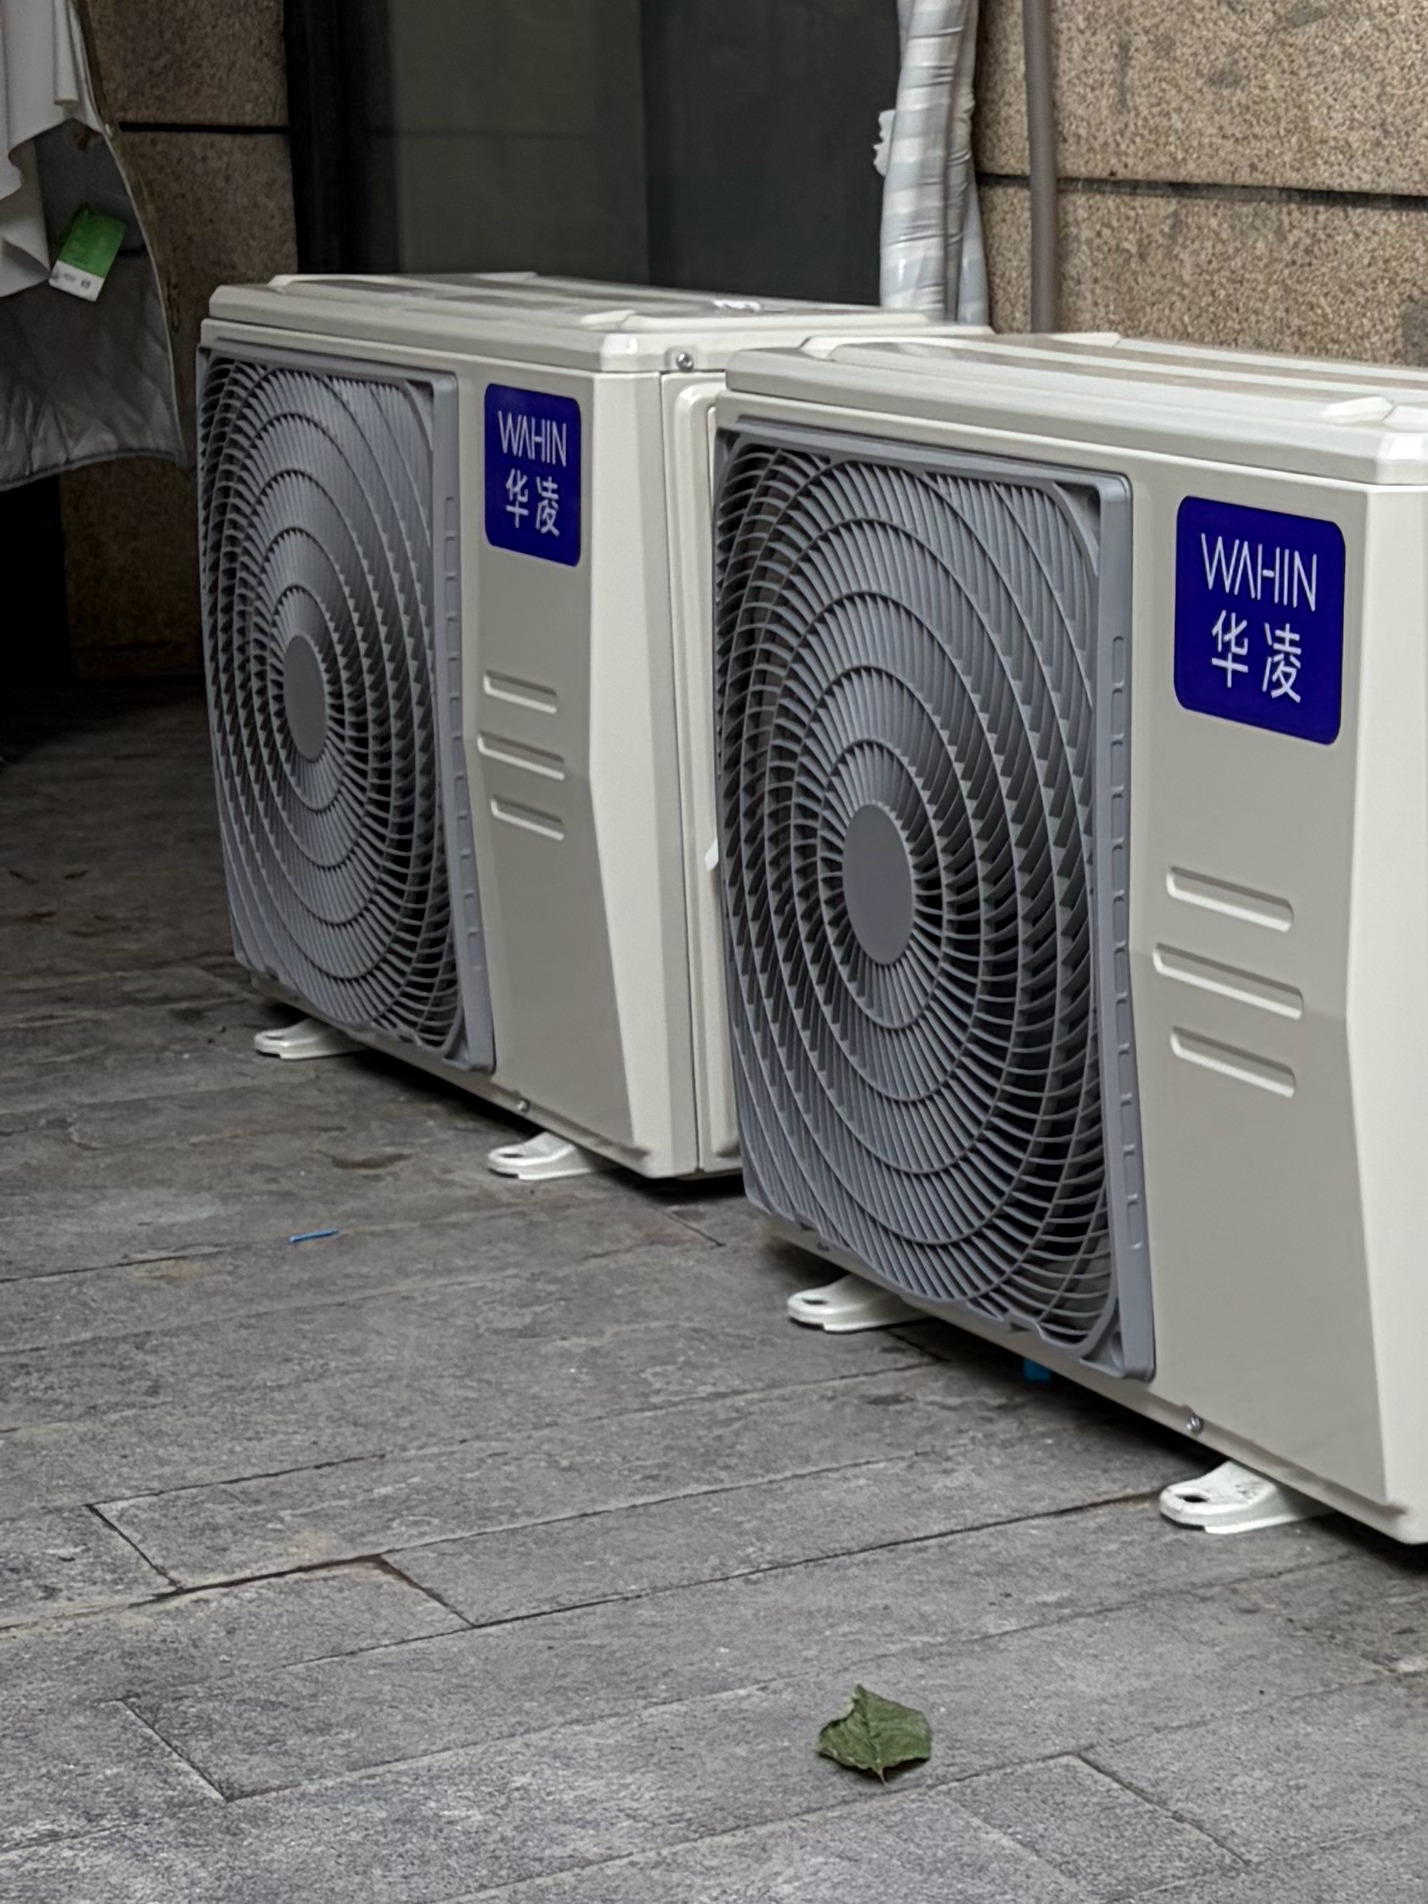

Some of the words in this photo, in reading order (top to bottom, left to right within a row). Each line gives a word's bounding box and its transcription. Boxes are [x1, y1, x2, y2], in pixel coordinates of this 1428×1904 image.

[498, 410, 567, 467] WAHIN
[505, 468, 560, 537] 华凌
[1201, 532, 1317, 612] WAHIN
[1211, 609, 1302, 704] 华凌
